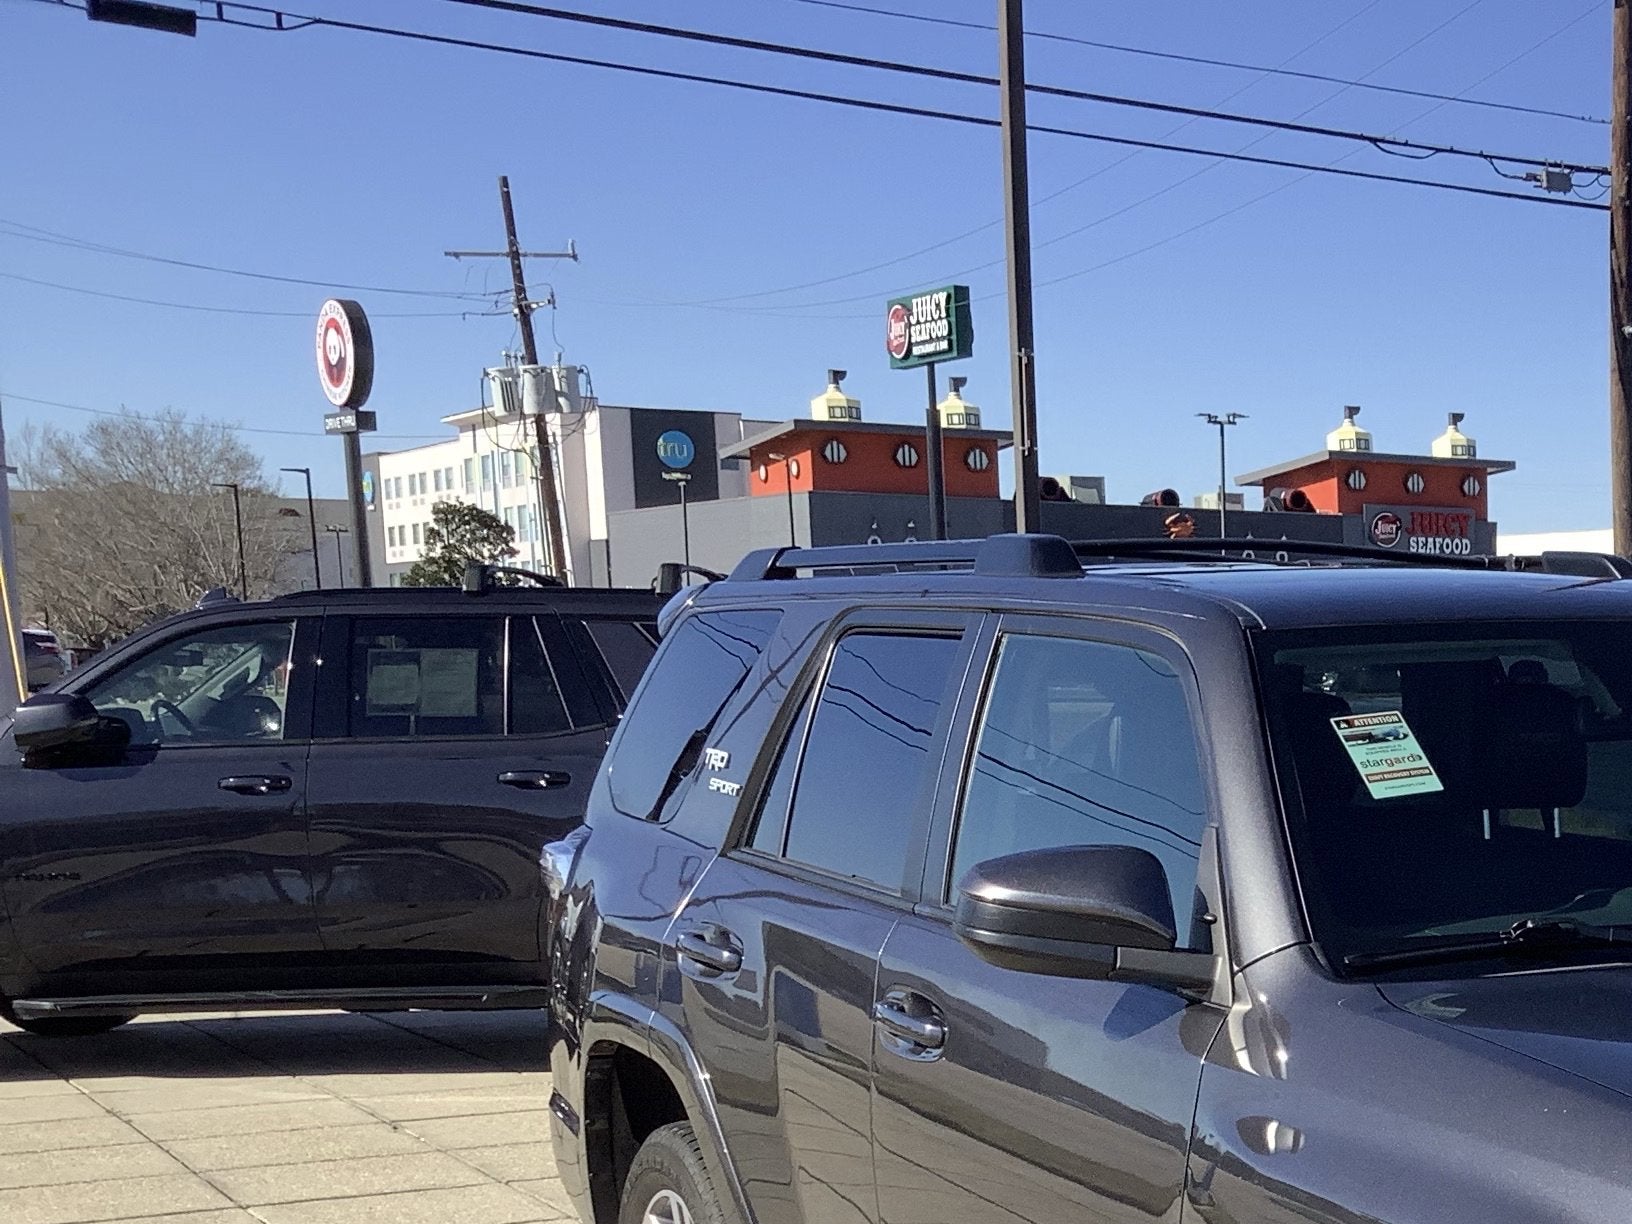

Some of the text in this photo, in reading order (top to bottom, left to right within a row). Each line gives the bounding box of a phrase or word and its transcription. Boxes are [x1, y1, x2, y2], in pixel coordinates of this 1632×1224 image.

[909, 292, 948, 324] JUICY
[910, 318, 949, 343] SEAFOOD
[659, 438, 688, 457] tru
[1405, 511, 1471, 537] JUICY
[1409, 536, 1471, 555] SEAFOOD
[1353, 715, 1400, 727] ATTENTION
[705, 747, 729, 772] TRD
[1360, 753, 1415, 769] stargard
[708, 777, 741, 797] SPORT
